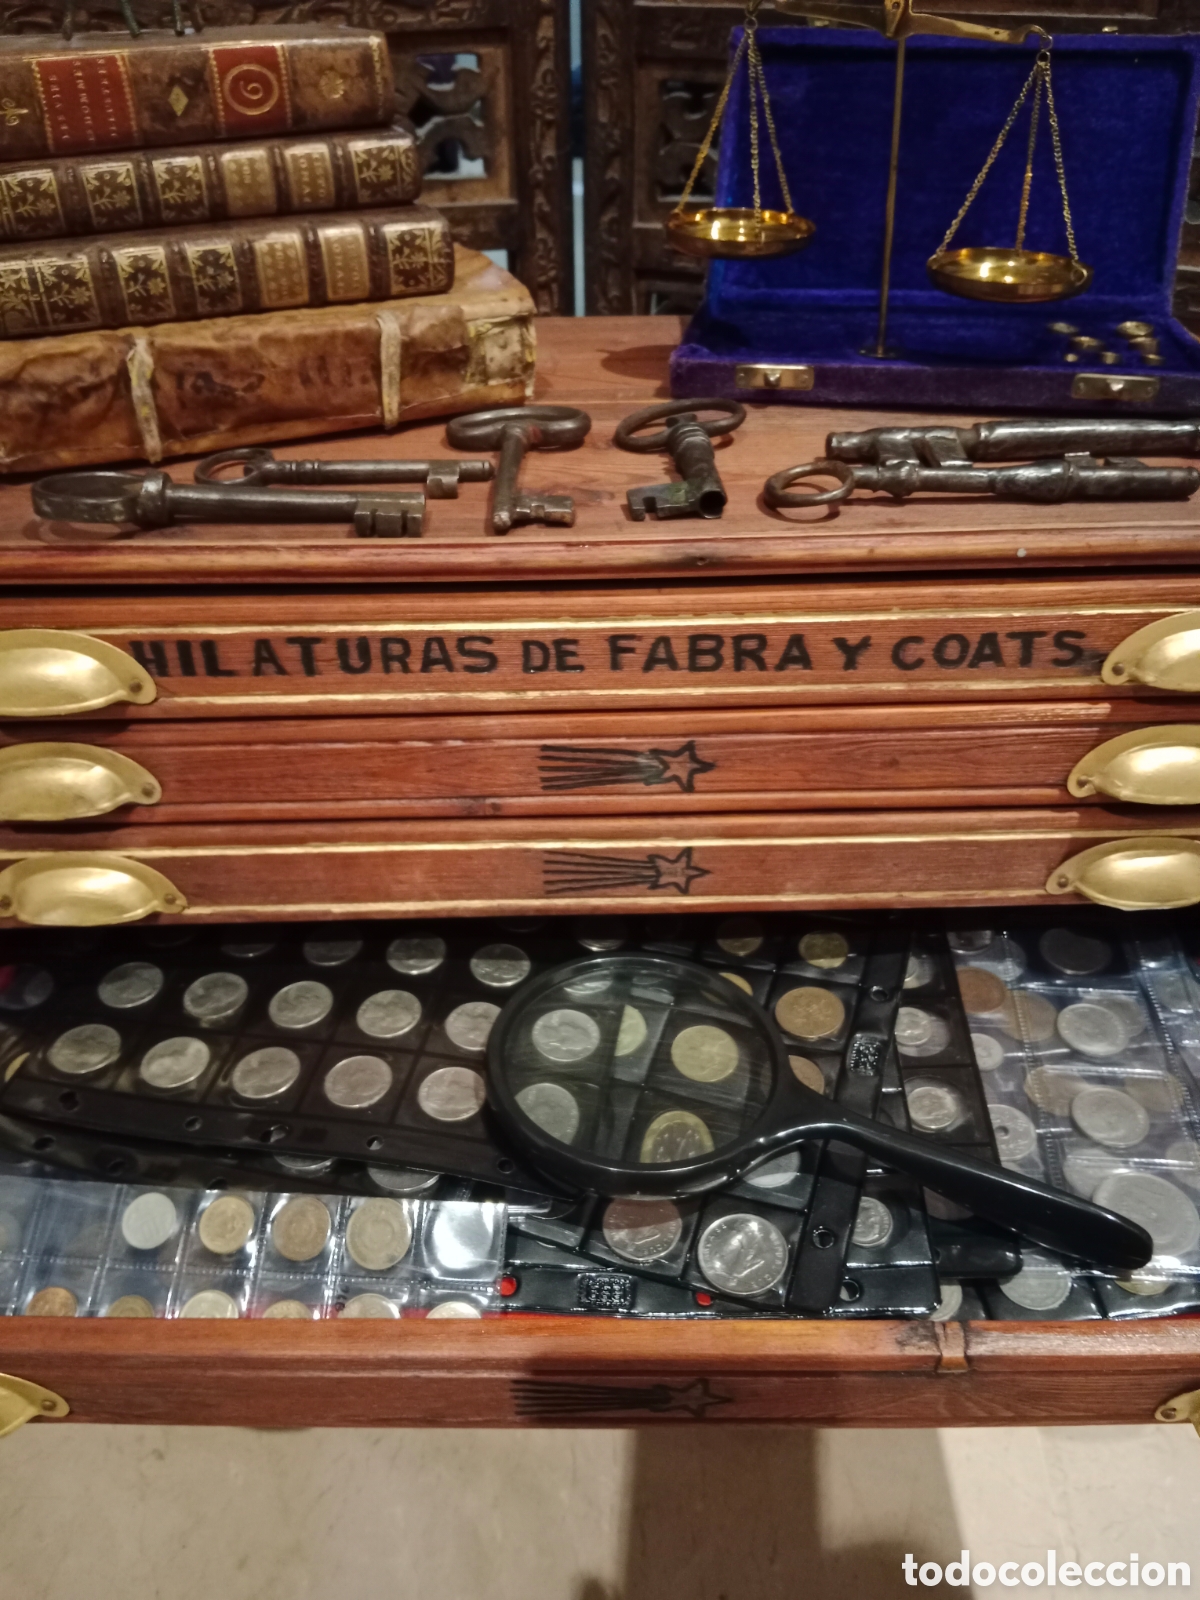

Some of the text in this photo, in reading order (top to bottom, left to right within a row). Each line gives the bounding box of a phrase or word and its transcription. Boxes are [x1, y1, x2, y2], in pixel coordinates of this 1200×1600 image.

[129, 629, 1087, 678] HILATURAS DE FABRA Y COATS
